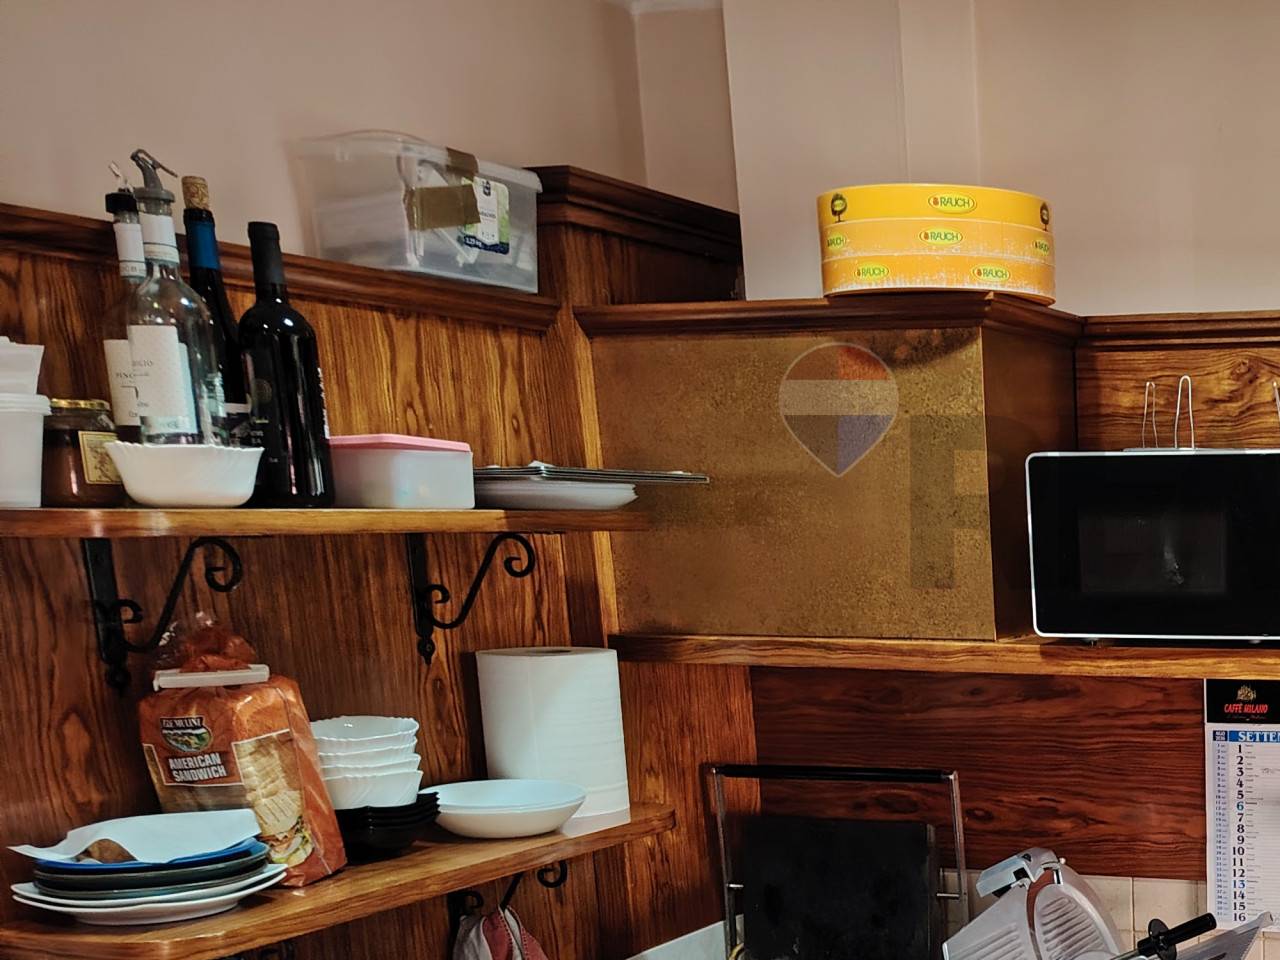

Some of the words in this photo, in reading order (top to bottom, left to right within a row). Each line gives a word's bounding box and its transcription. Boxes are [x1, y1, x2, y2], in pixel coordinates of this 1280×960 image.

[940, 196, 970, 208] RAUCH
[930, 231, 959, 242] RAUCH
[861, 267, 886, 277] RAUCH
[982, 268, 1008, 278] RAUCH
[168, 752, 222, 770] AMERICAN
[172, 765, 227, 782] SANDWICH
[1233, 847, 1245, 855] 10
[1233, 858, 1243, 866] 11
[1233, 869, 1245, 877] 12
[1233, 880, 1245, 888] 13
[1233, 891, 1245, 899] 14
[1234, 902, 1246, 910] 15
[1234, 913, 1246, 921] 16
